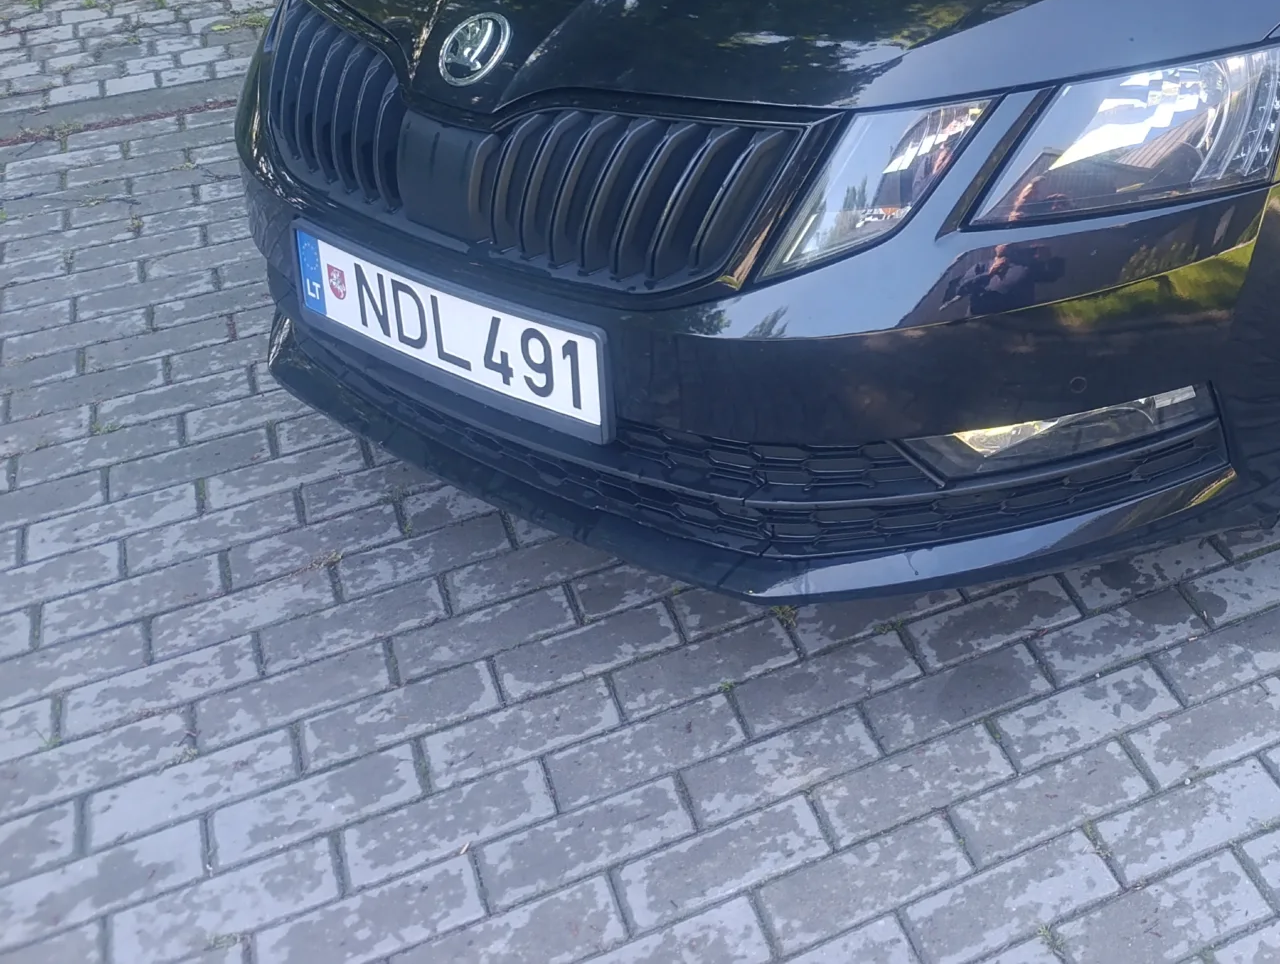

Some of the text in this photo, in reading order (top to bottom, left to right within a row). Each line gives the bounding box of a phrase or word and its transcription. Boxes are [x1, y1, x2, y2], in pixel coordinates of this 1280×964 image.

[306, 278, 321, 300] LT
[353, 262, 582, 410] NDL 491
